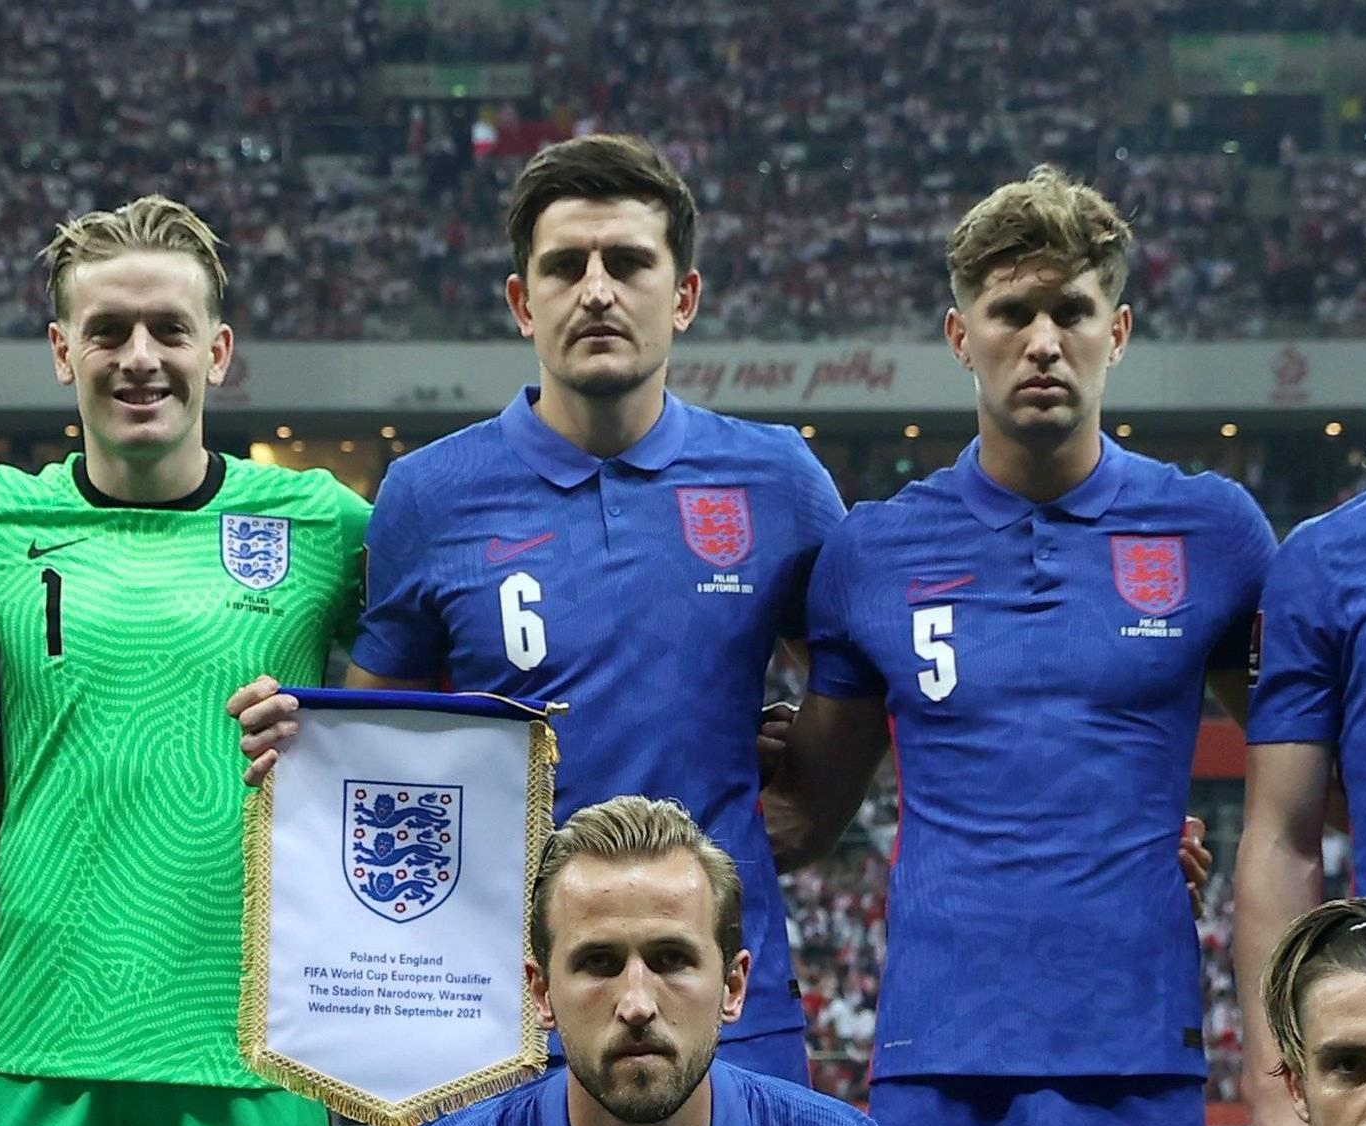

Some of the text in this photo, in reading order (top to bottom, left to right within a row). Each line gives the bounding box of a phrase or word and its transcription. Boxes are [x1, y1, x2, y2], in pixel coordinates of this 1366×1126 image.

[41, 568, 63, 657] 1
[499, 571, 547, 671] 6
[913, 605, 957, 702] 5
[350, 952, 386, 964] Poland
[399, 953, 443, 967] England
[303, 967, 492, 985] FIFA World Cup European Qualifier
[309, 984, 329, 996] The
[332, 985, 374, 998] Stadion
[439, 990, 483, 1002] Warsaw
[308, 1002, 482, 1019] Wednesday 8th September 2021
